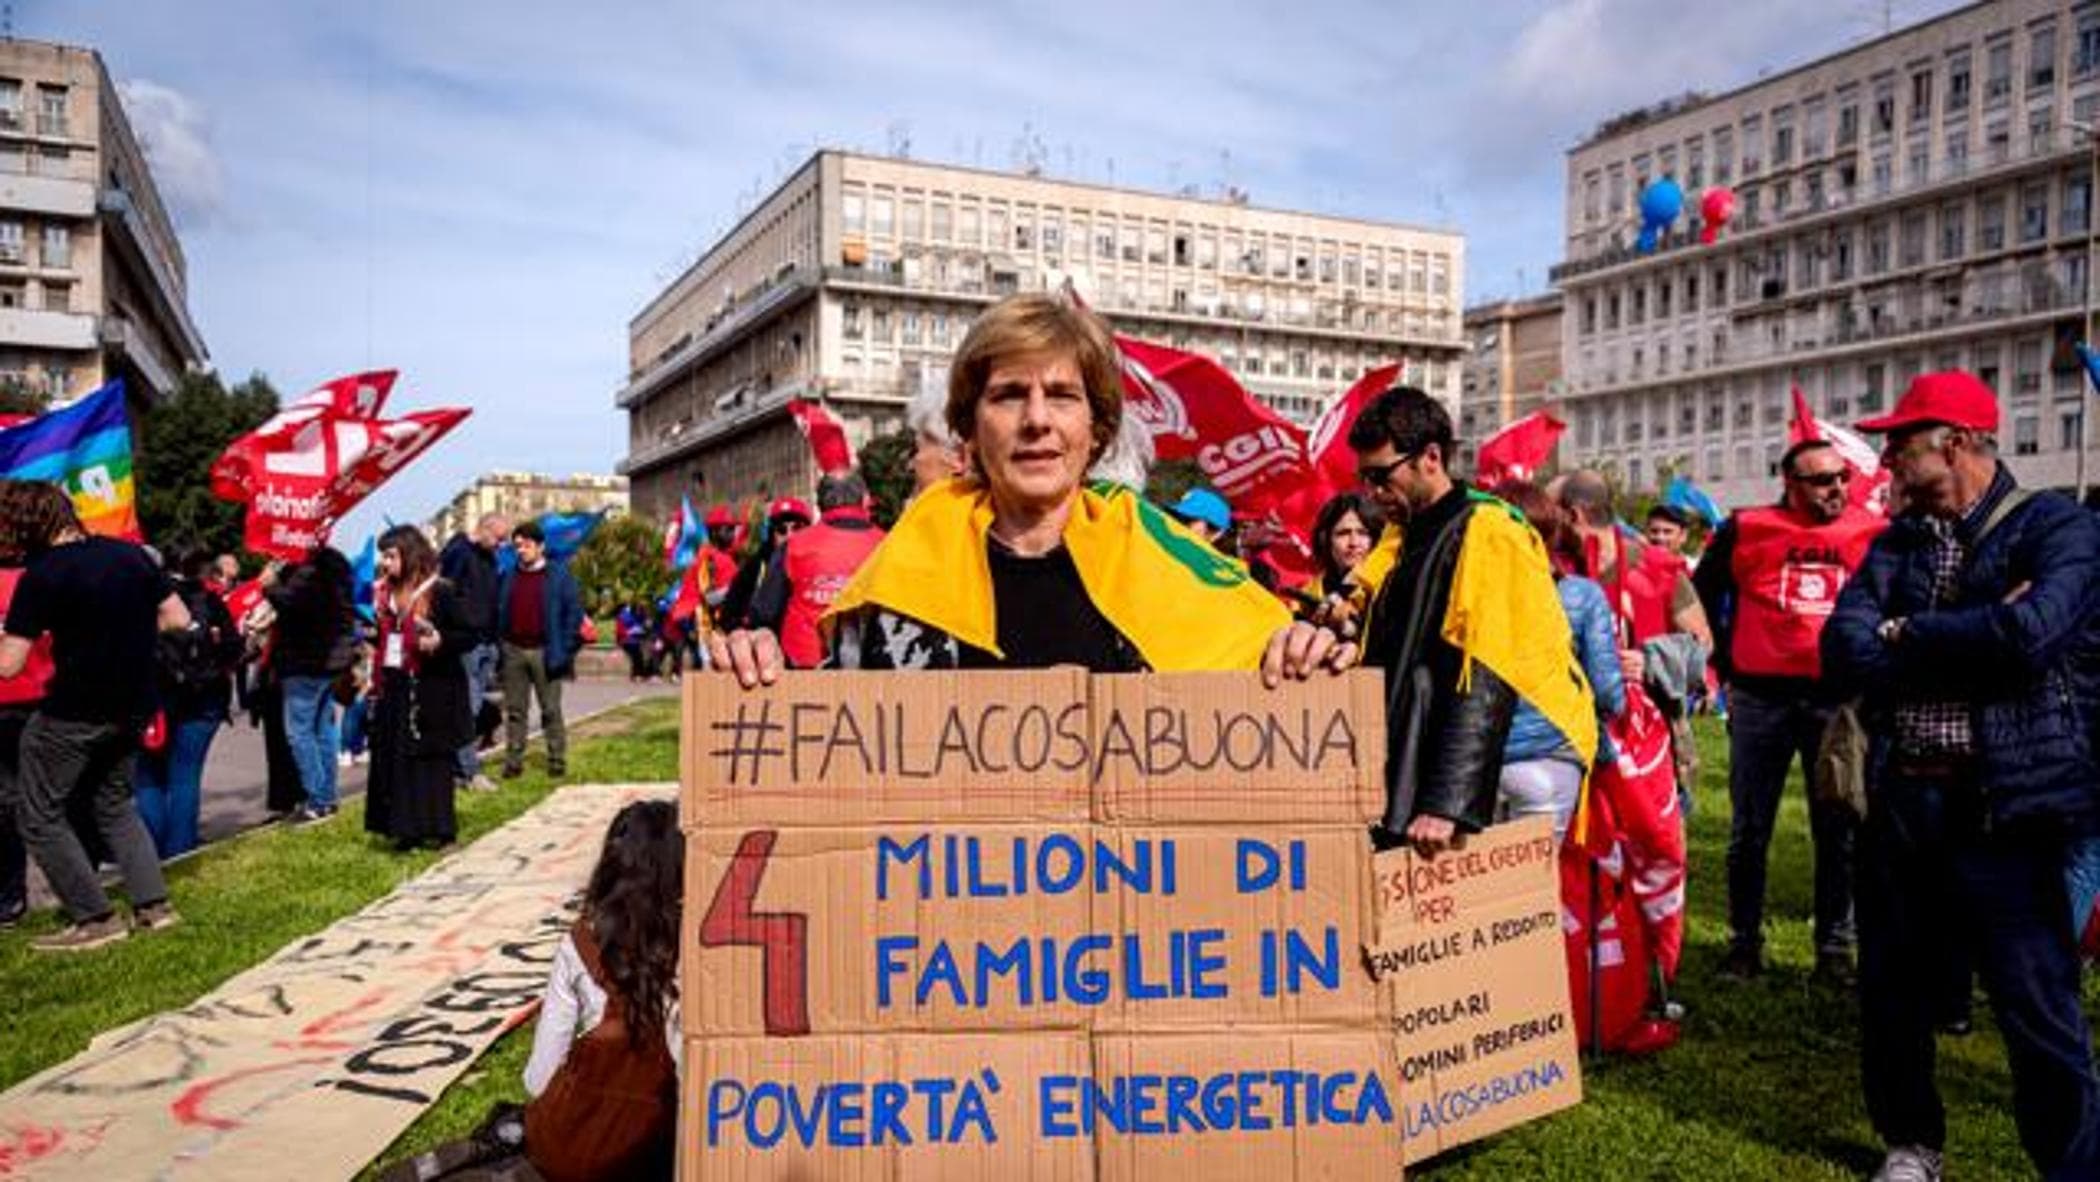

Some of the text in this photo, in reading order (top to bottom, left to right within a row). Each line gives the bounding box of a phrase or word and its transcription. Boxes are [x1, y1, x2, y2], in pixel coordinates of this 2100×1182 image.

[1198, 424, 1301, 476] CGIL
[709, 700, 1358, 786] #FAILACOSABUONA
[1457, 852, 1488, 879] DEL
[699, 830, 1306, 1037] 4 MILIONI DI
[1416, 895, 1456, 925] PER
[1472, 928, 1488, 951] A
[1492, 911, 1557, 947] REDDITO
[876, 928, 1341, 1009] FAMIGLIE IN
[1398, 1012, 1565, 1083] OMINI PERIFERICI
[1040, 1070, 1394, 1138] ENERGETICA
